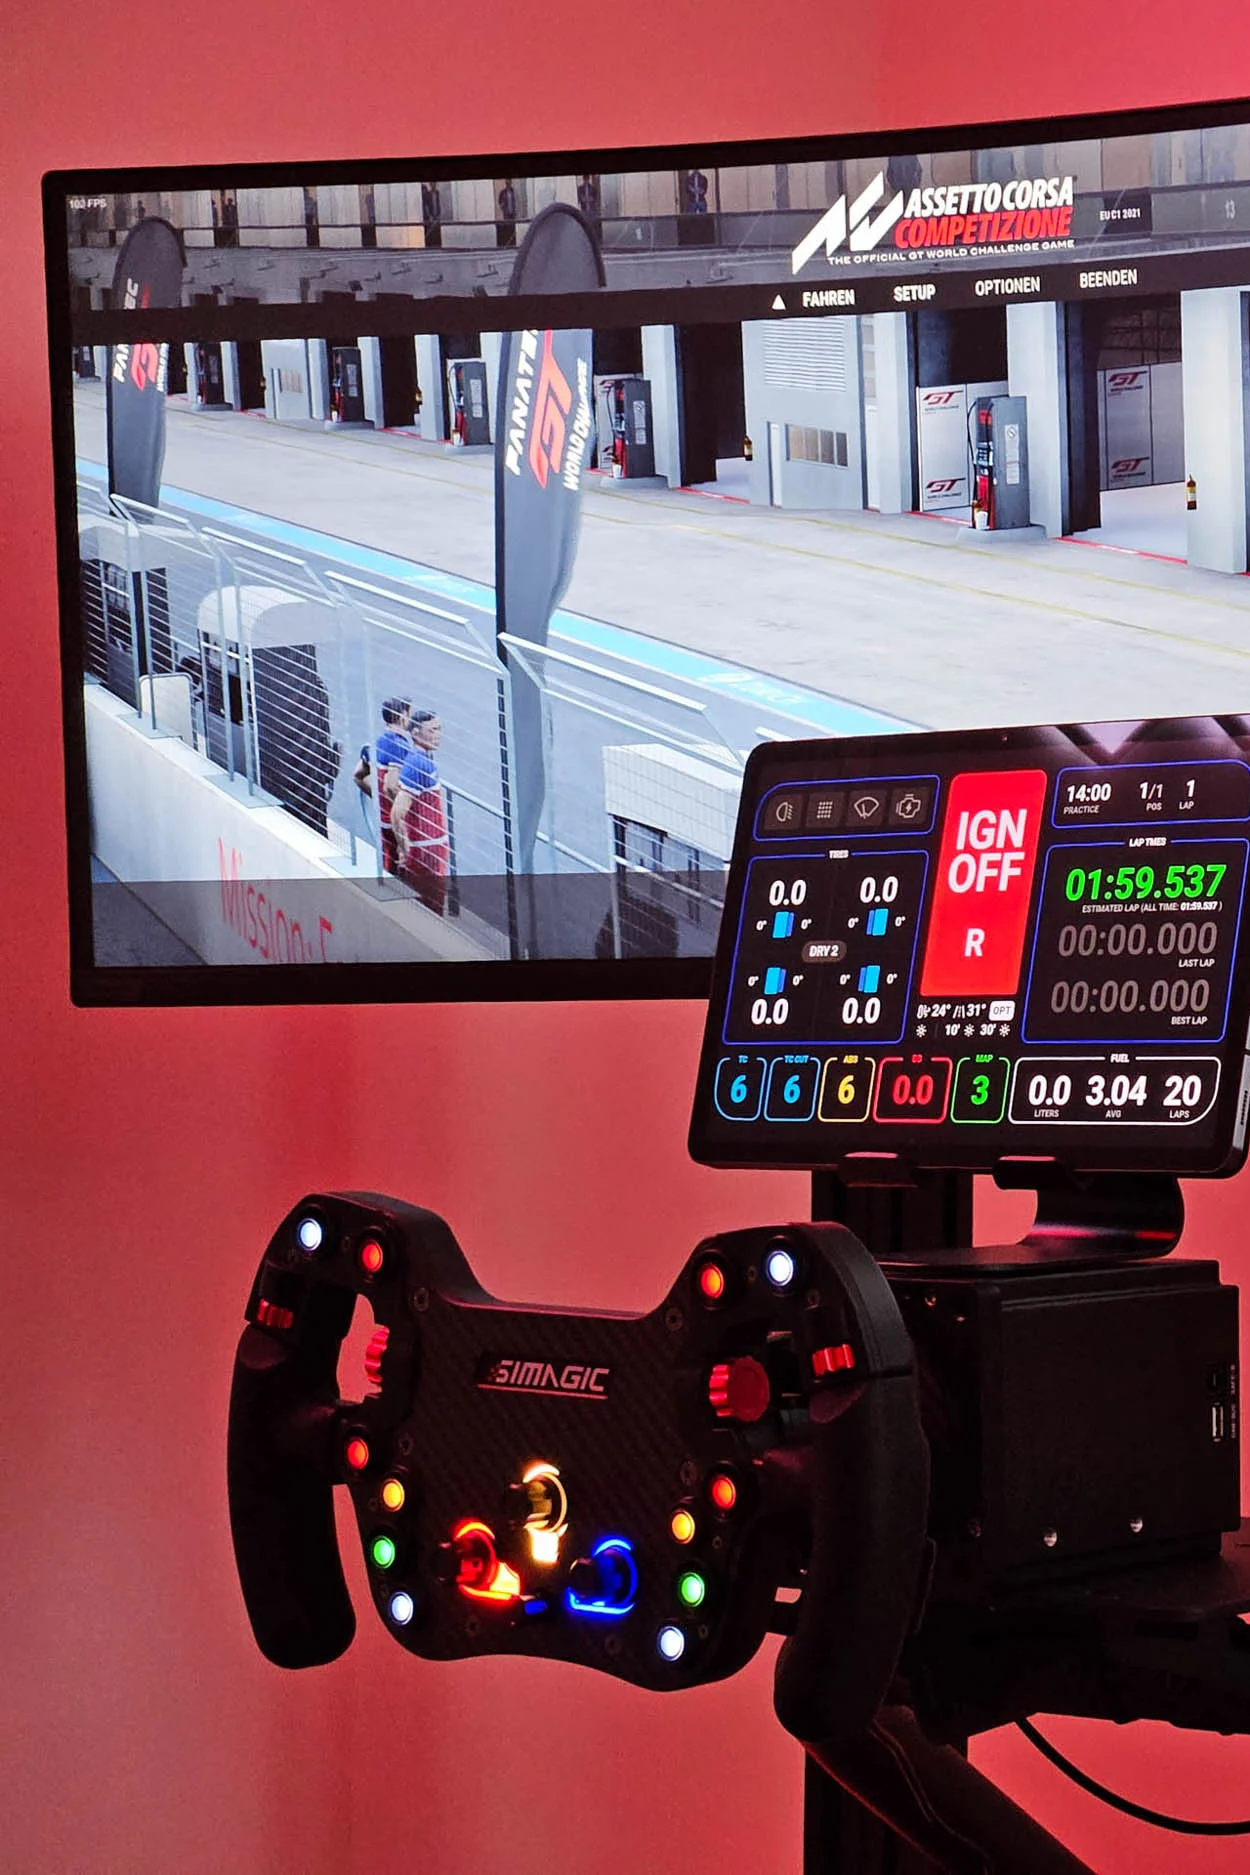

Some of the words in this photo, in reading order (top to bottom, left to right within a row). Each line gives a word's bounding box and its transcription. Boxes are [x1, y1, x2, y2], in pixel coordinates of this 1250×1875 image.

[88, 198, 107, 208] FPS
[904, 182, 1002, 218] ASSETTO
[1002, 176, 1074, 210] CORSA
[1100, 210, 1111, 221] EU
[1122, 208, 1141, 219] 2021
[1225, 201, 1235, 218] 13
[894, 206, 1073, 248] COMPETIZIONE
[828, 256, 851, 265] THE
[854, 252, 906, 264] OFFICIAL
[908, 250, 925, 260] GT
[927, 247, 967, 259] WORLD
[969, 242, 1039, 256] CHALLENGE
[1042, 239, 1075, 250] GAME
[975, 276, 1040, 297] OPTIONEN
[1080, 269, 1138, 288] BEENDEN
[802, 288, 855, 307] FAHREN
[894, 284, 935, 302] SETUP
[505, 329, 538, 476] FANATE
[563, 434, 585, 491] WORLD
[1067, 783, 1112, 803] 14:00
[1140, 782, 1163, 800] 1/1
[1186, 780, 1196, 797] 1
[1064, 804, 1100, 814] PRACTICE
[1146, 802, 1162, 811] POS
[1179, 801, 1194, 810] LAP
[956, 808, 1028, 850] IGN
[1129, 838, 1144, 848] LAP
[1144, 837, 1167, 847] TIMES
[948, 852, 1025, 894] OFF
[1065, 864, 1227, 901] 01:59.537
[769, 879, 807, 906] 0.0
[860, 876, 899, 903] 0.0
[1082, 904, 1124, 914] ESTIMATED
[1124, 903, 1140, 912] LAP
[1140, 902, 1158, 913] (ALL
[1180, 901, 1218, 911] 01:59.537
[809, 946, 829, 957] DRY
[830, 945, 839, 956] 2
[964, 928, 986, 957] R
[1058, 922, 1218, 957] 00:00.000
[1178, 959, 1198, 968] LAST
[1199, 958, 1215, 968] LAP
[1051, 979, 1210, 1014] 00:00.000
[751, 998, 789, 1024] 0.0
[842, 997, 881, 1024] 0.0
[932, 1004, 952, 1018] 24°
[966, 1004, 986, 1017] 31°
[993, 1006, 1012, 1016] OPT
[1171, 1016, 1190, 1025] BEST
[1192, 1016, 1208, 1025] LAP
[738, 1055, 748, 1064] TC
[784, 1055, 794, 1064] TC
[794, 1055, 808, 1064] CUT
[976, 1054, 994, 1063] MAP
[1110, 1054, 1130, 1064] FUEL
[730, 1074, 747, 1104] 6
[784, 1074, 800, 1104] 6
[838, 1074, 855, 1104] 6
[892, 1074, 934, 1105] 0.0
[970, 1074, 990, 1106] 3
[1028, 1074, 1072, 1106] 0.0
[1086, 1074, 1147, 1106] 3.04
[1162, 1074, 1202, 1106] 20
[1034, 1109, 1060, 1118] LITERS
[1105, 1110, 1122, 1118] AVG
[1169, 1110, 1190, 1119] LAPS
[496, 1360, 609, 1392] SIMAGIC
